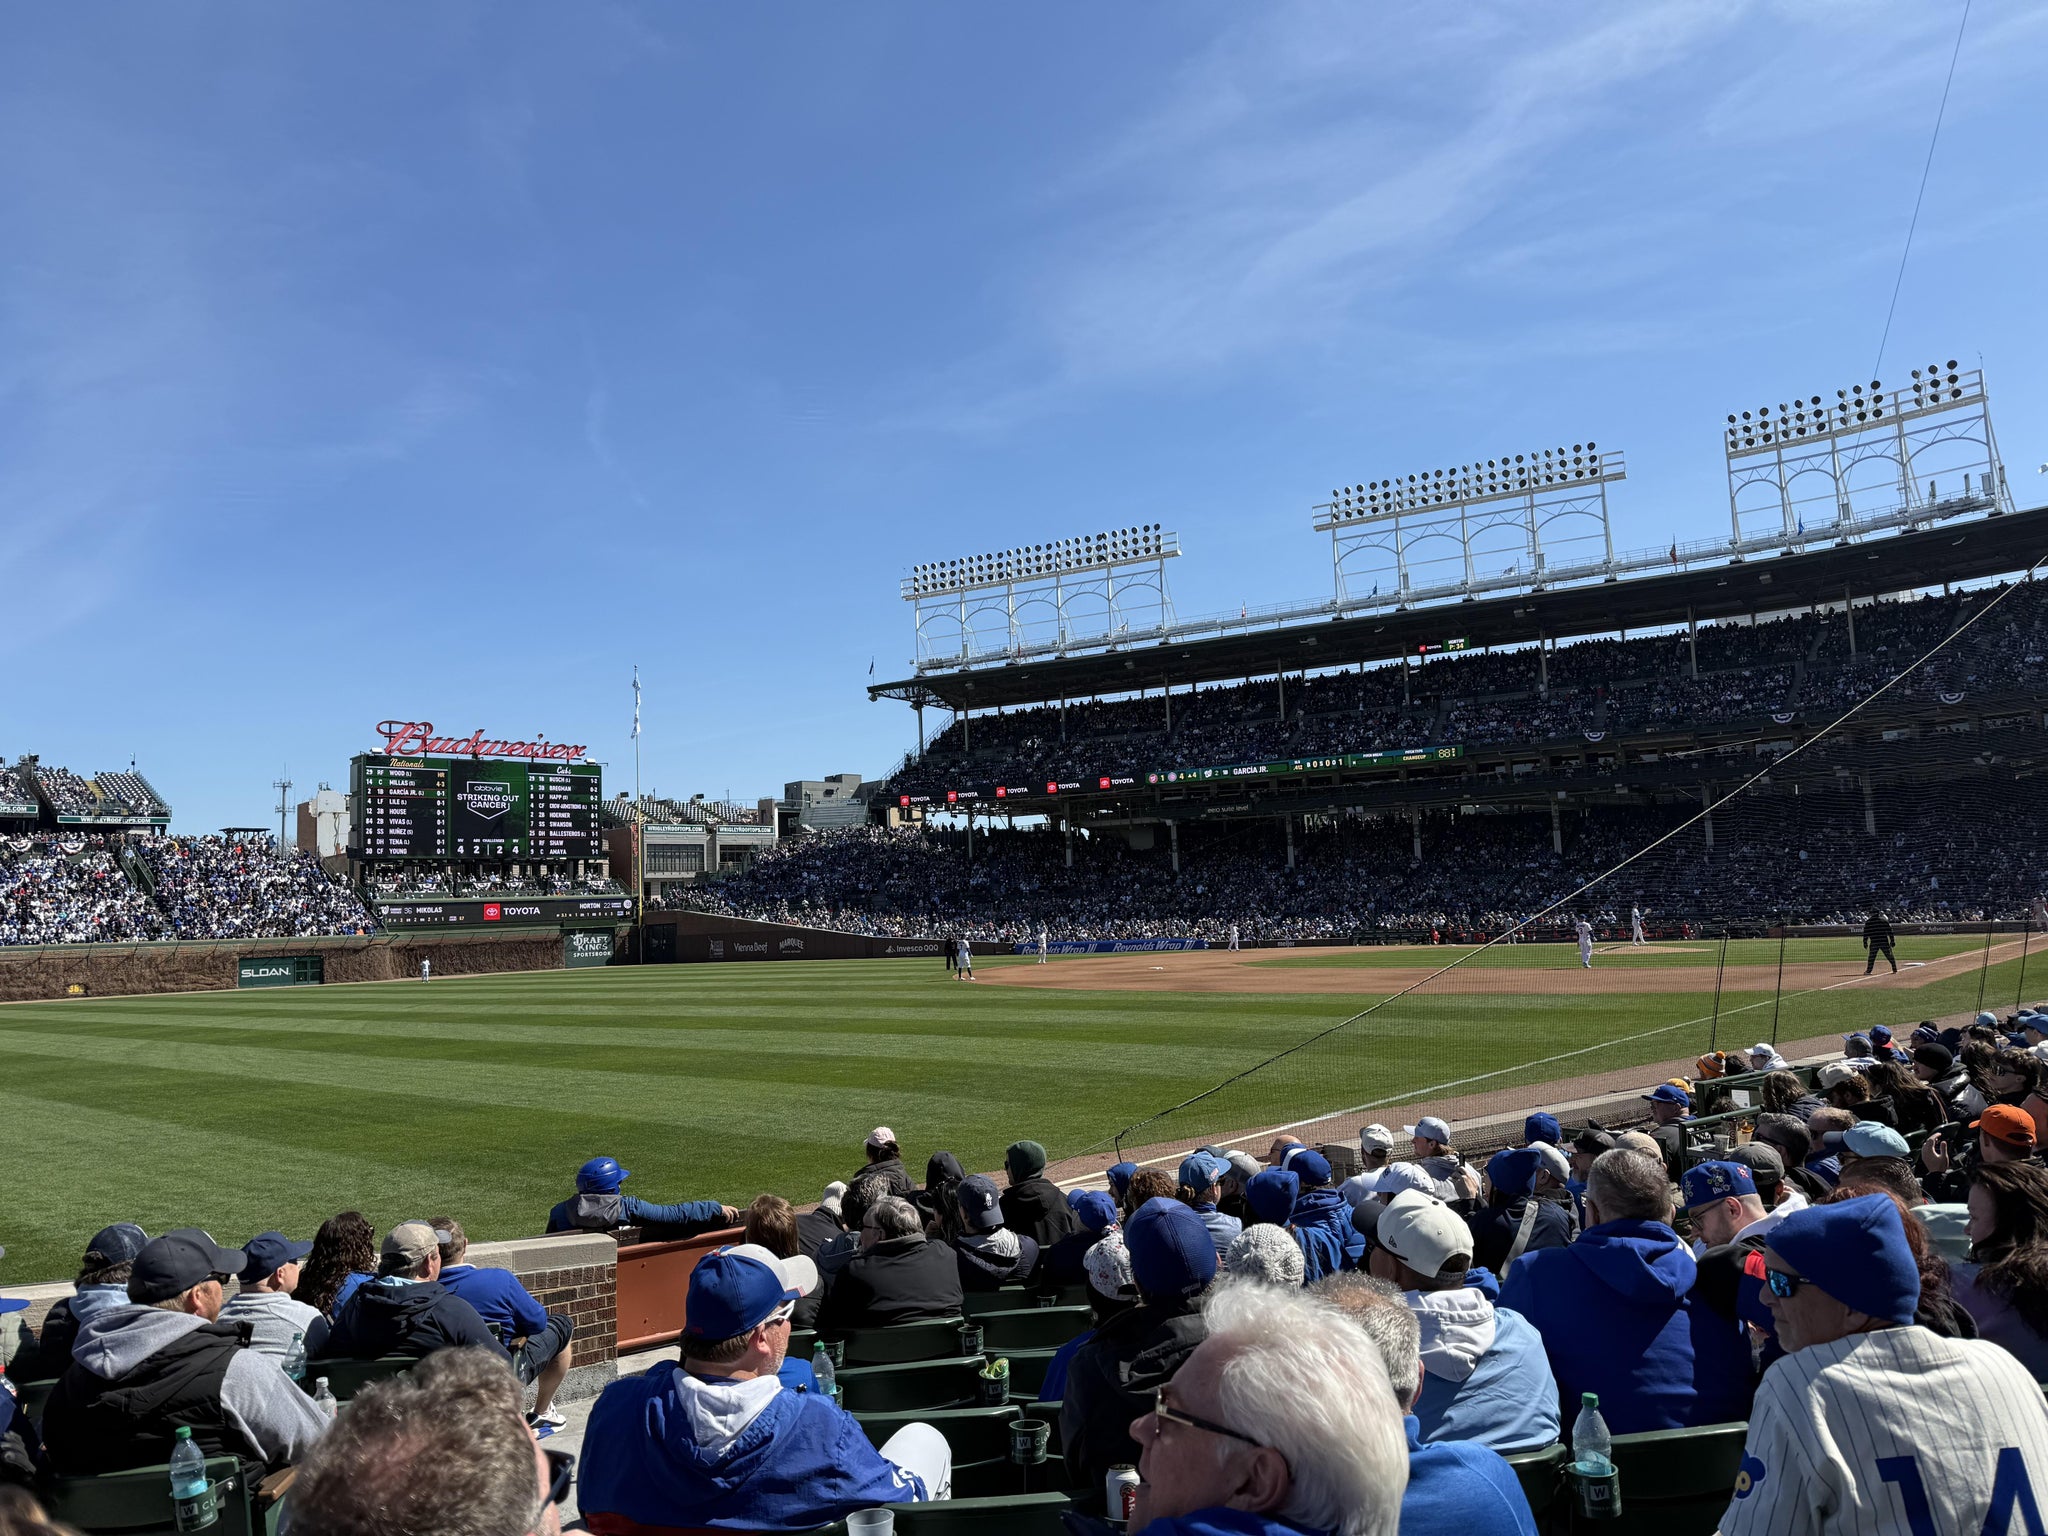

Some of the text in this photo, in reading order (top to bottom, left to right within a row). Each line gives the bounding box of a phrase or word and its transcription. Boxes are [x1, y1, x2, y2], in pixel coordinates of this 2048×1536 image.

[376, 720, 587, 759] Budweiser
[1438, 749, 1450, 758] 88
[390, 758, 424, 768] Nationals
[556, 766, 572, 774] Cubs
[1233, 766, 1258, 775] GARCÍA
[457, 846, 519, 854] 4 2 2 4
[503, 907, 541, 915] TOYOTA
[573, 936, 608, 946] DRAFT
[779, 938, 804, 950] MARQUEE
[578, 943, 608, 951] KINGS
[734, 942, 753, 952] Vienna
[754, 942, 768, 953] Beef
[1061, 945, 1085, 953] Wrap
[1113, 941, 1181, 952] Reynolds Wrap
[1594, 1487, 1606, 1499] W
